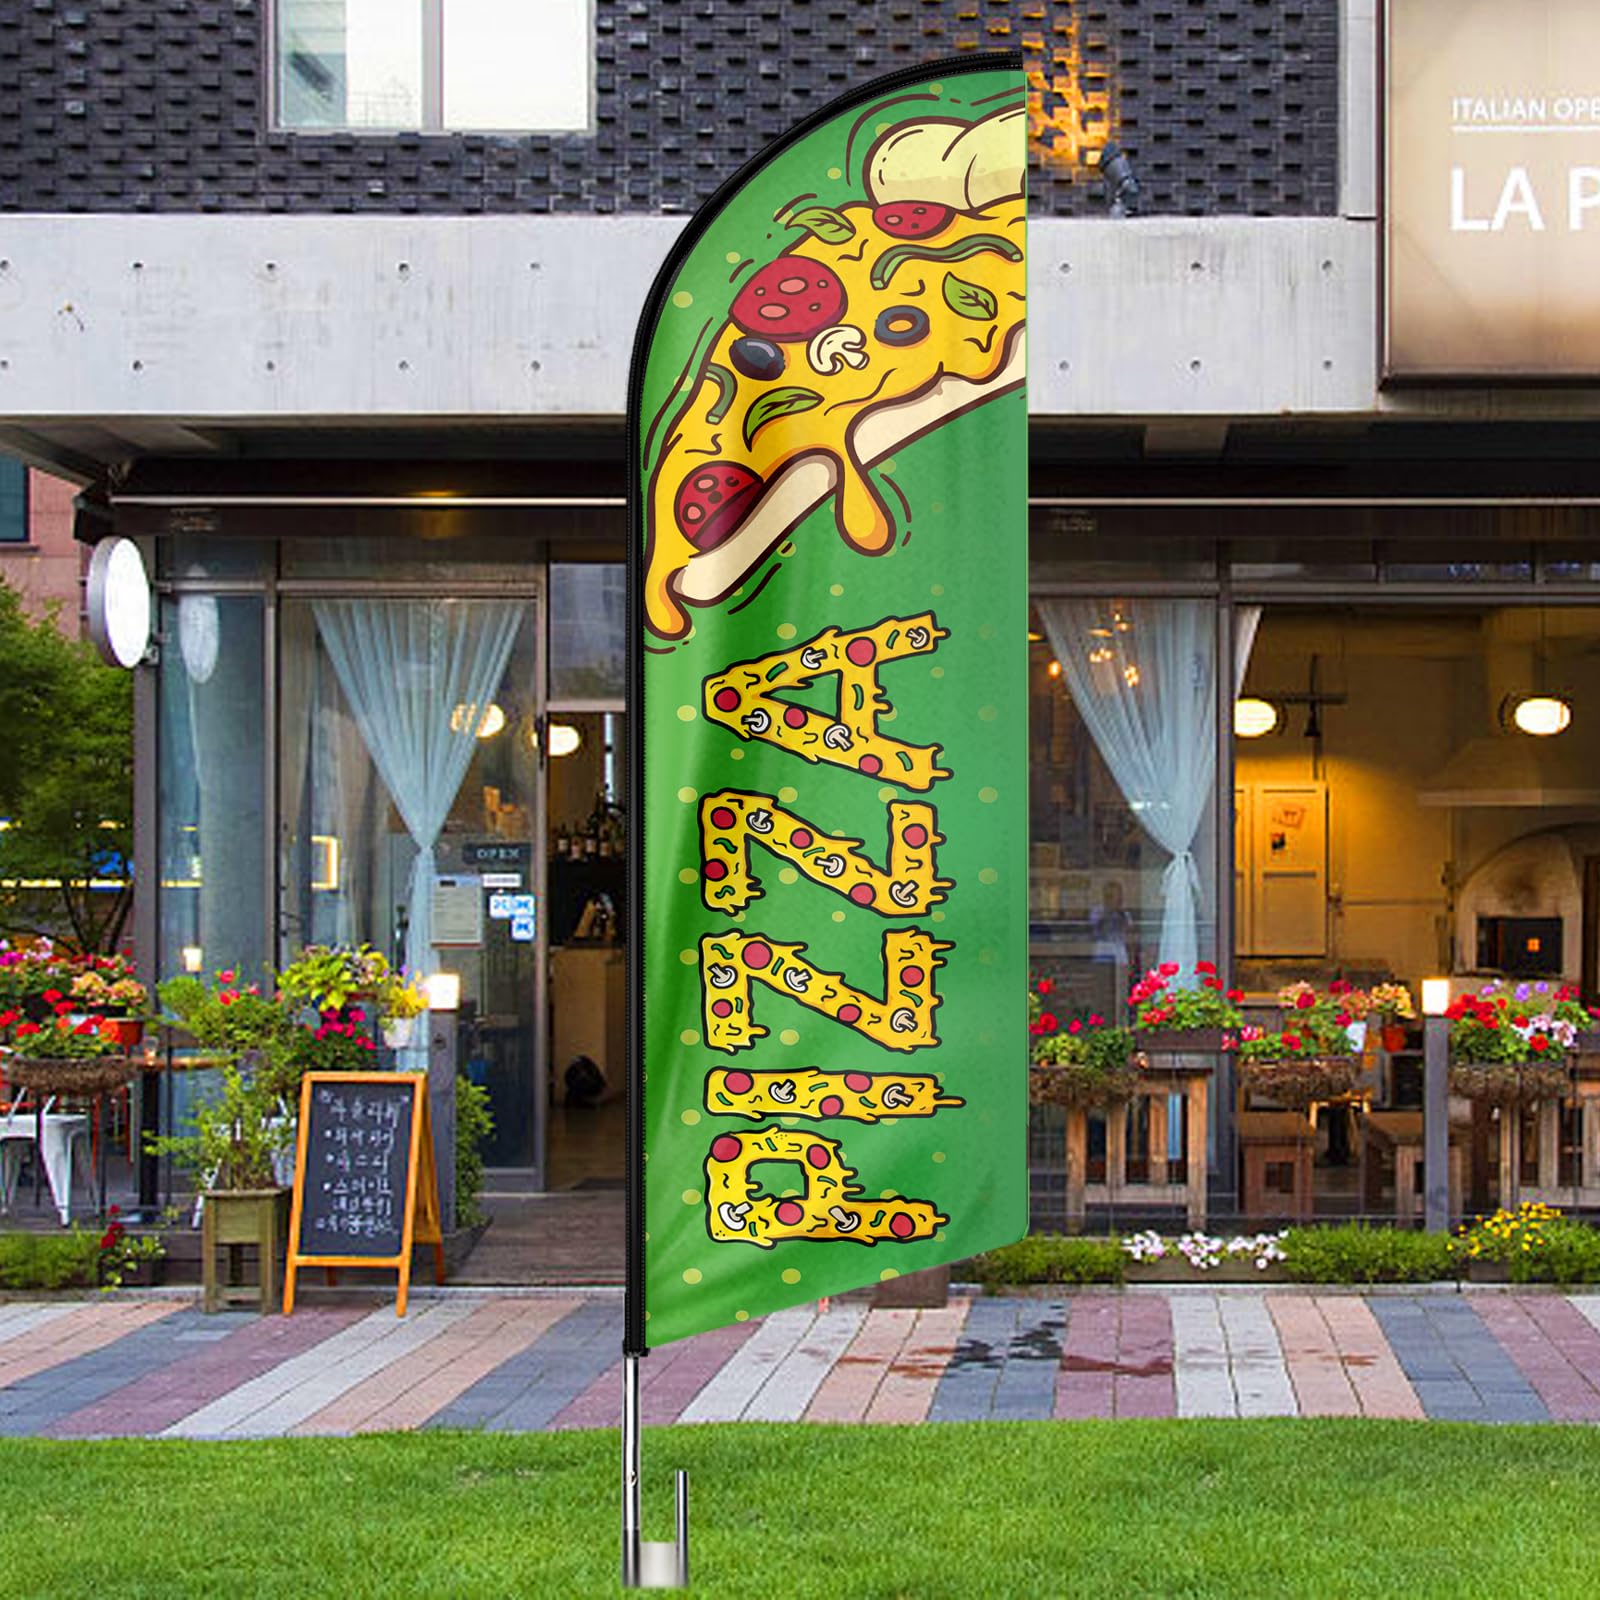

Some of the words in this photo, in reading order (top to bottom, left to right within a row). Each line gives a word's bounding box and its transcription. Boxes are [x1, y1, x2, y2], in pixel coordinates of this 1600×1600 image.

[1451, 96, 1546, 121] ITALIAN
[1451, 166, 1546, 231] LA
[700, 610, 966, 1247] PIZZA
